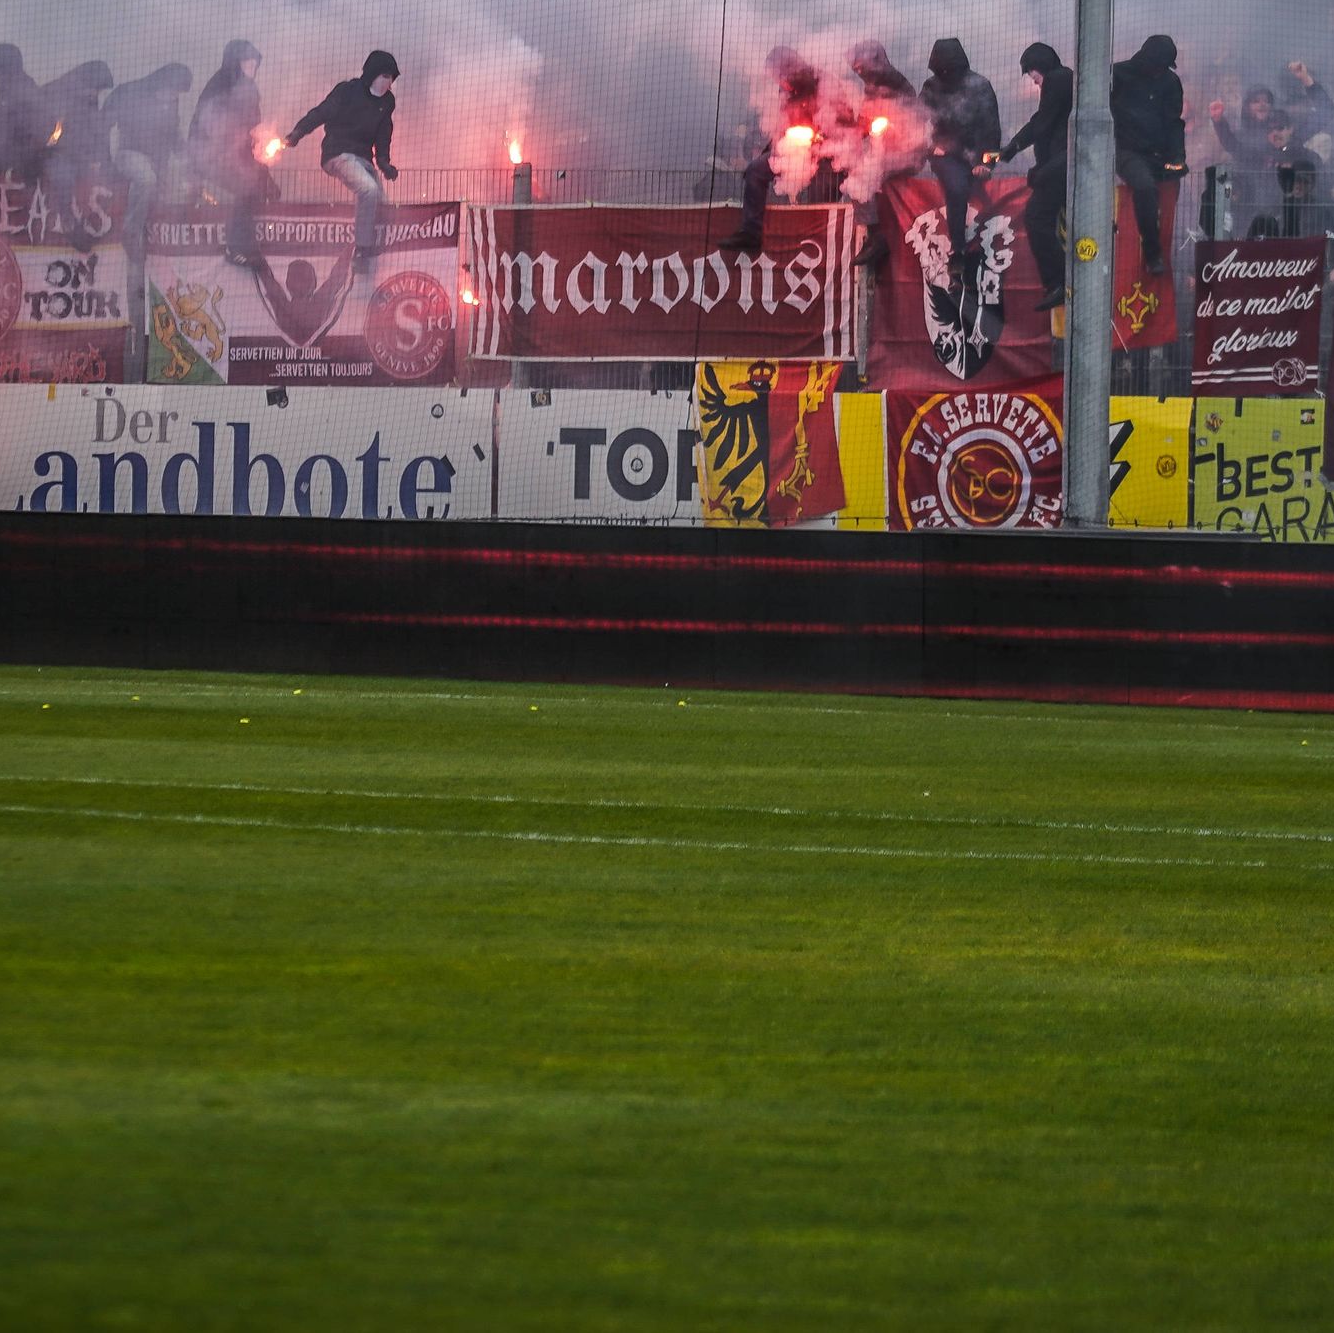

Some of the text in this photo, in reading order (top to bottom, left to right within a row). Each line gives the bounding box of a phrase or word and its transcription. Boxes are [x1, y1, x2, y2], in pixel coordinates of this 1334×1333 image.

[255, 222, 355, 244] SUPPORTERS
[374, 213, 455, 247] THURGAU
[45, 254, 98, 289] ON
[499, 239, 823, 314] maroons
[1202, 248, 1318, 283] Amoureux
[25, 290, 121, 321] TOUR
[1215, 298, 1242, 317] ce
[427, 315, 449, 332] FC
[229, 347, 283, 362] SERVETTIEN
[285, 347, 299, 361] UN
[423, 338, 444, 366] 1890
[331, 361, 373, 377] TOUJOURS
[91, 398, 179, 444] Der
[1216, 443, 1322, 502] BEST
